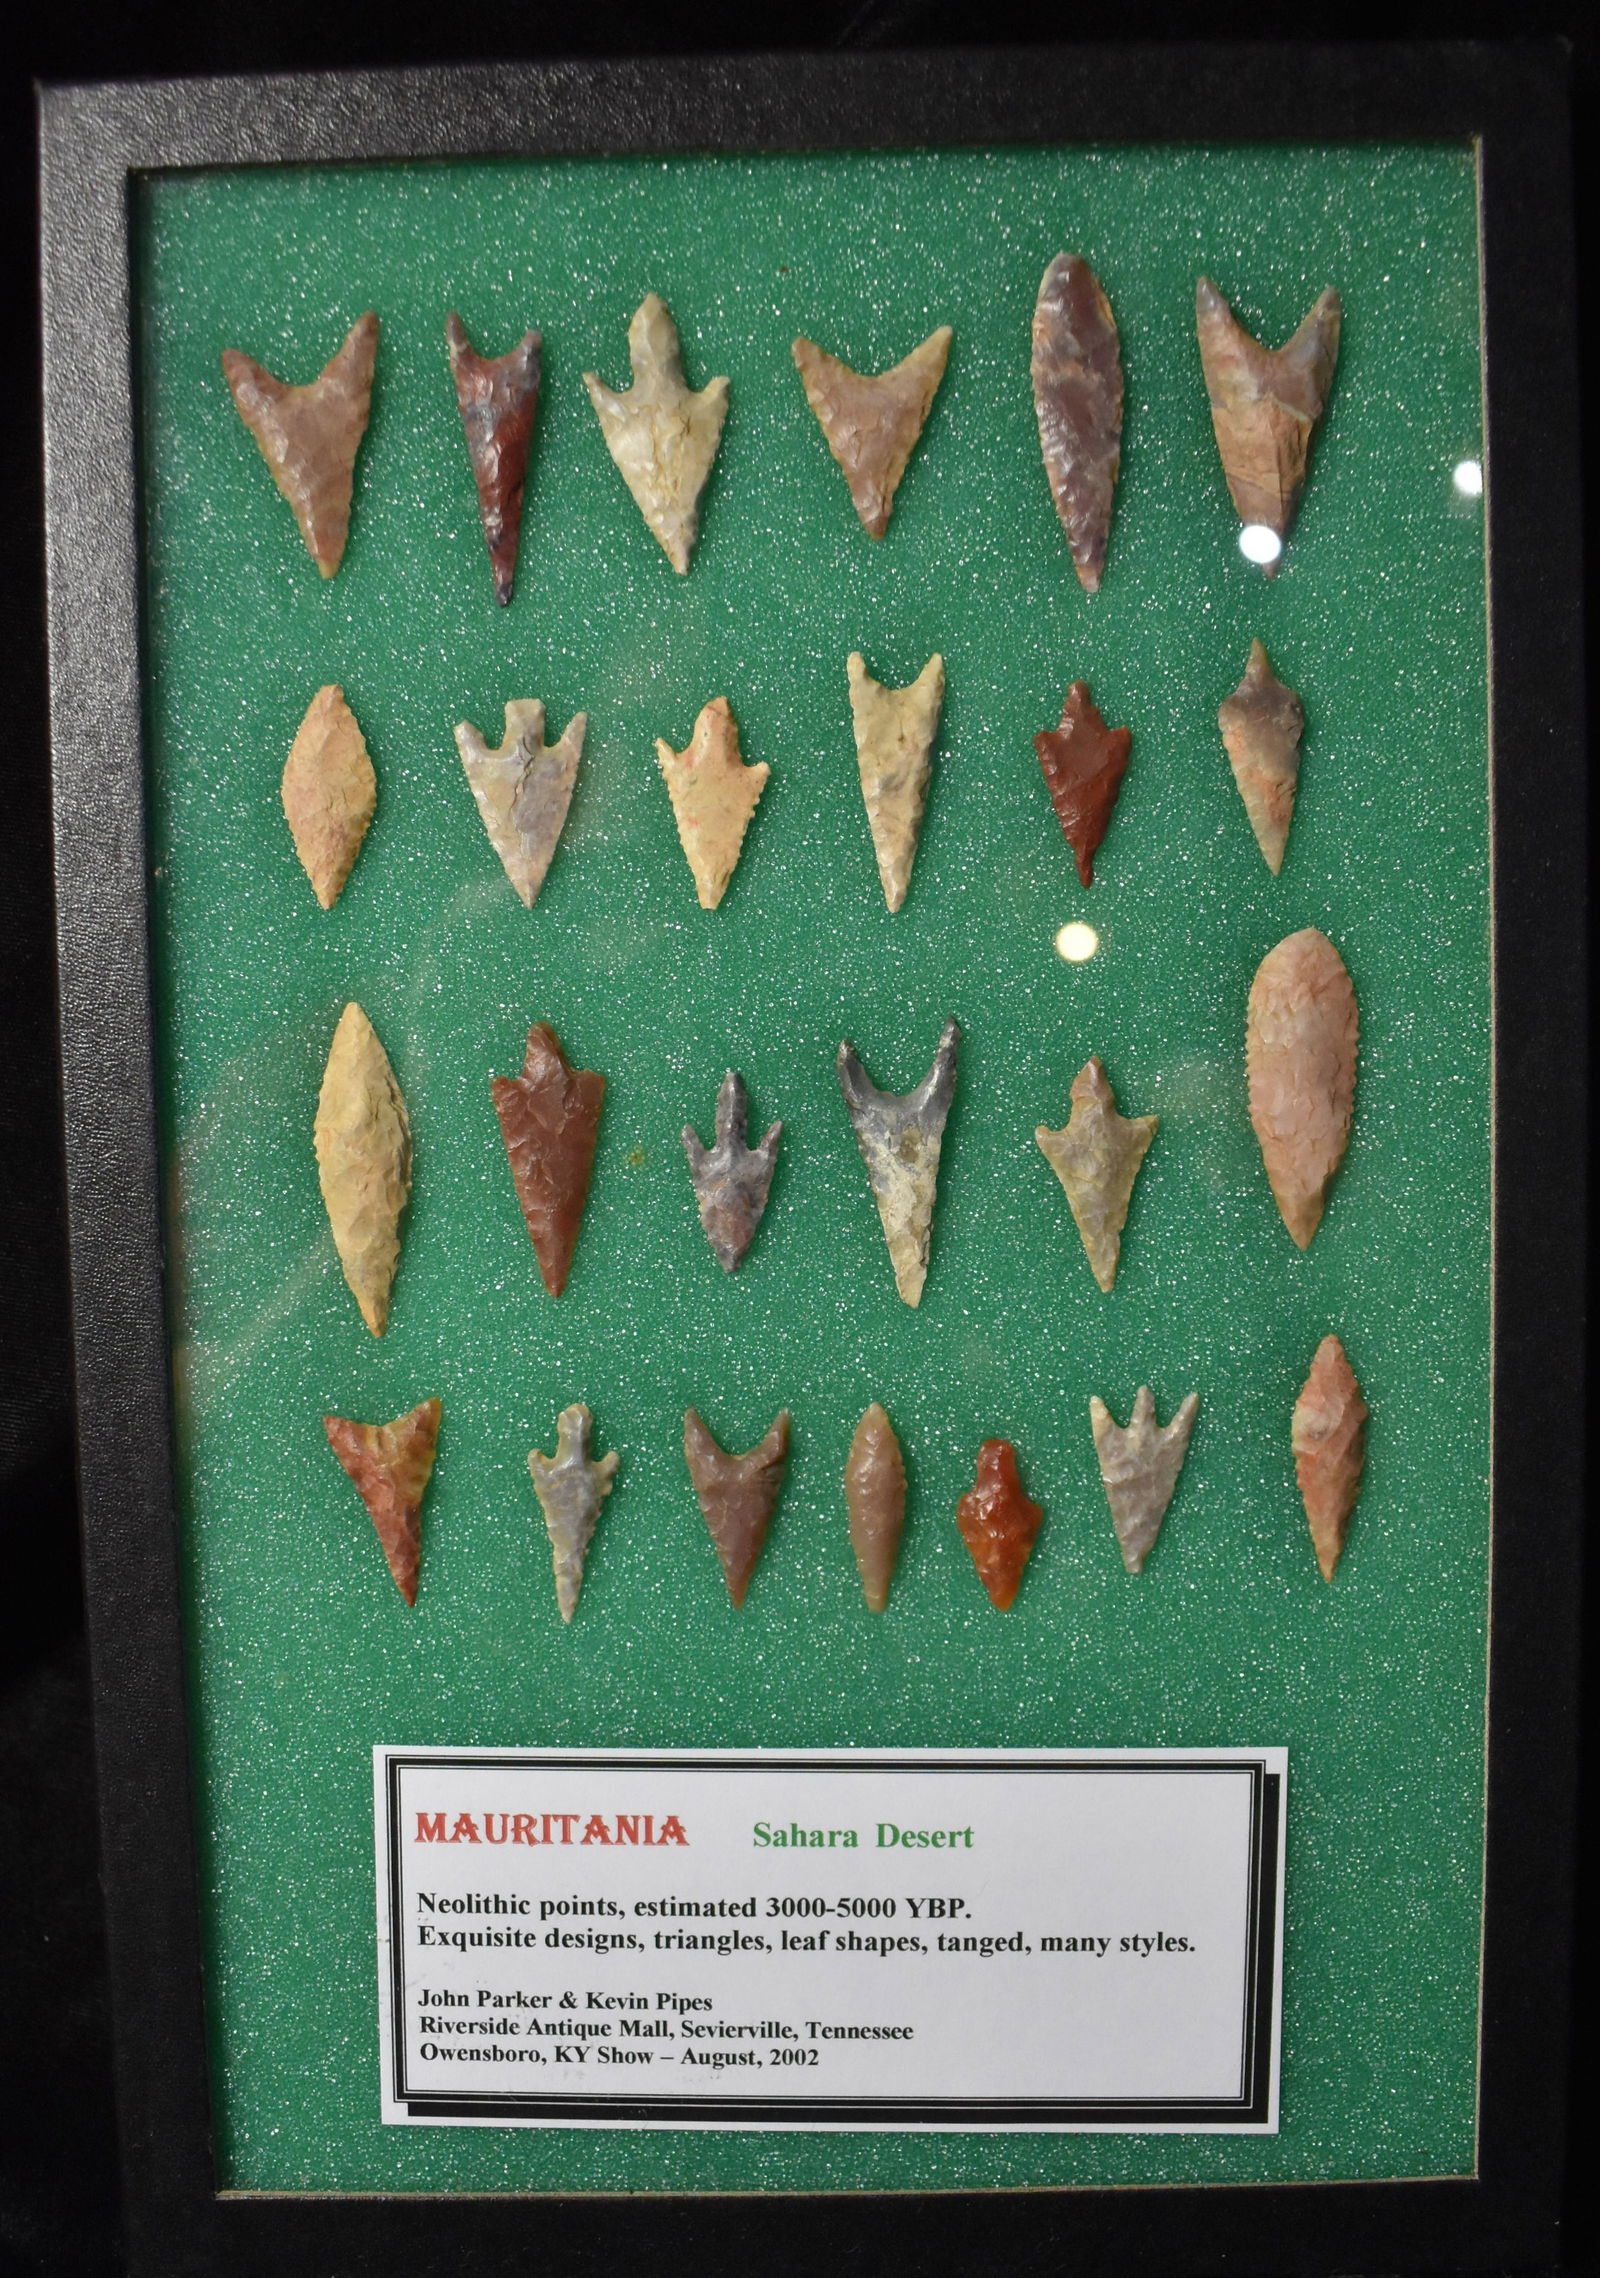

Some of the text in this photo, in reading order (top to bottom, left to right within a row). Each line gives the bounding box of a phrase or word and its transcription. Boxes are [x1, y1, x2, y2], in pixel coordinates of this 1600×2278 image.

[415, 1812, 974, 1849] MAURITANIA Sahara Desert
[417, 1892, 972, 1921] Neolithic points, estimated 3000-5000 YBP.
[418, 1925, 1196, 1958] Exquisite designs, triangles, leaf shapes, tanged, many styles.
[417, 1989, 713, 2016] John Parker & Kevin Pipes
[420, 2016, 914, 2042] Riverside Antique Mall, Sevierville, Tennessee
[420, 2042, 547, 2066] Owensboro,
[554, 2045, 591, 2063] KY
[597, 2045, 652, 2065] Show
[680, 2047, 763, 2070] August,
[769, 2048, 819, 2066] 2002
